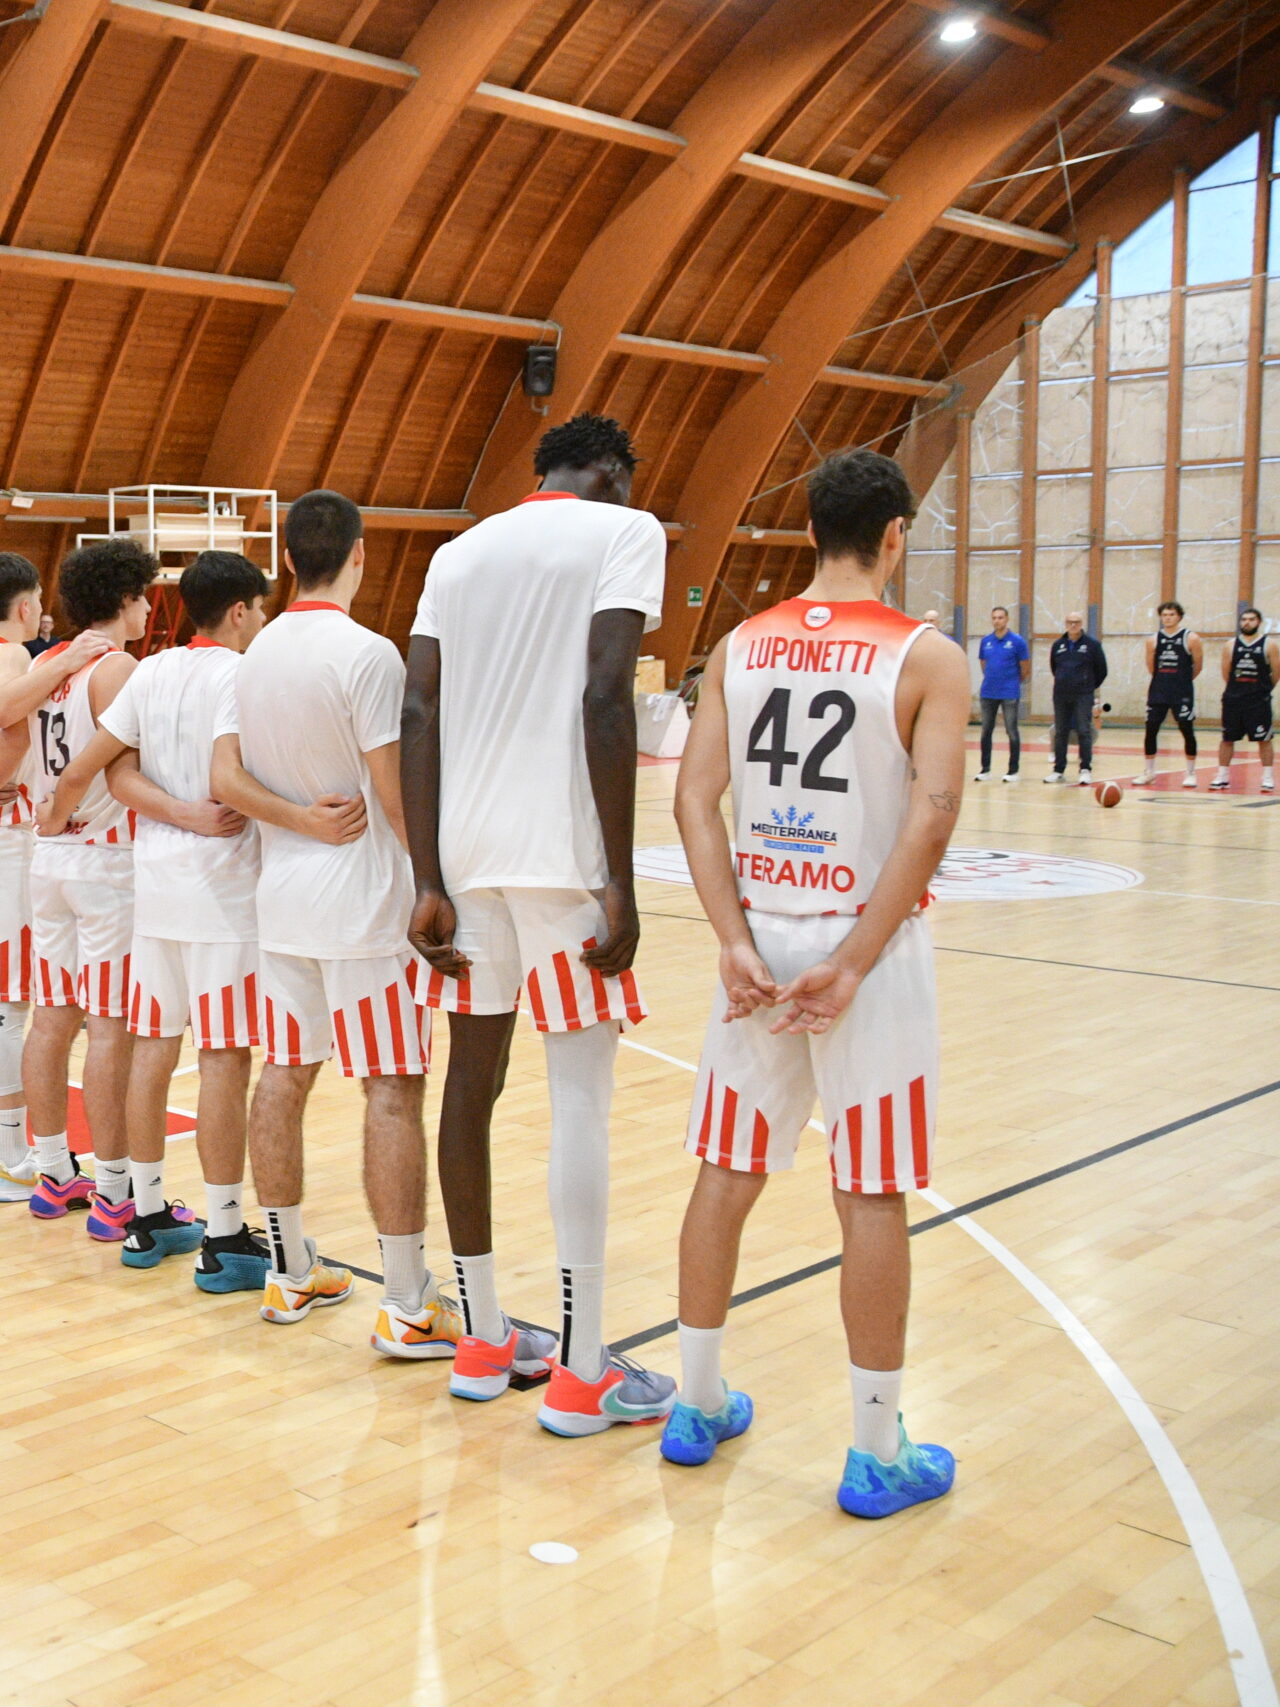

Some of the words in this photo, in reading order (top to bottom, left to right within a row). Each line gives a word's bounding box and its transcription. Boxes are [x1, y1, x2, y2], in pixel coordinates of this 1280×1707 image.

[746, 636, 878, 675] LUPONETTI
[38, 709, 70, 776] 13
[746, 687, 857, 794] 42
[751, 822, 838, 842] METERRANEA
[735, 851, 856, 893] TERAMO
